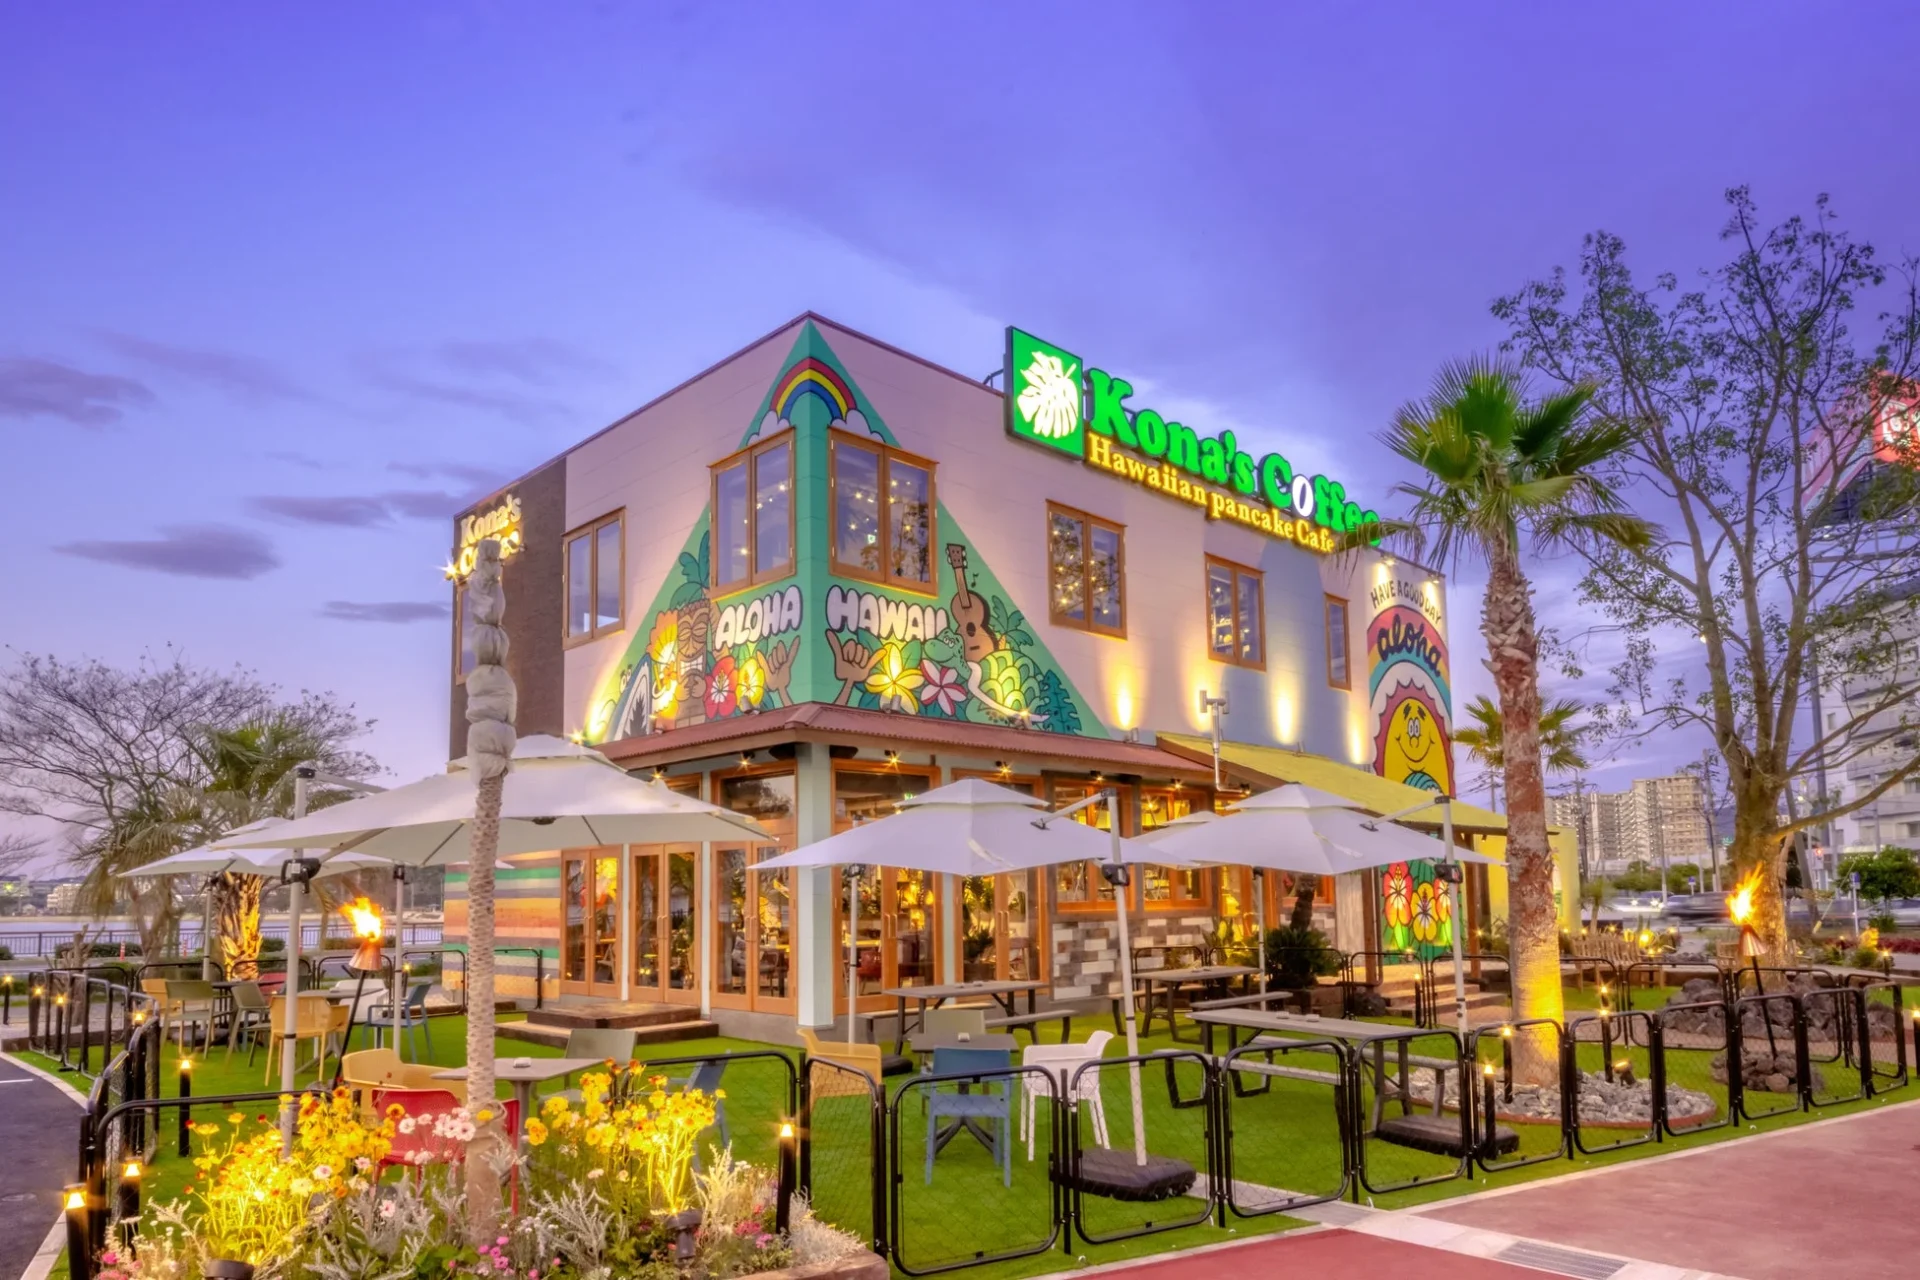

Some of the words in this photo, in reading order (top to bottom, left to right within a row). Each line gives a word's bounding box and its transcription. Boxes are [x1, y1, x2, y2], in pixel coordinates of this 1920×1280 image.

[1087, 367, 1256, 495] Kona's
[460, 493, 522, 548] Kona's
[1087, 430, 1208, 506] Hawaiian
[1210, 491, 1294, 540] pancake
[1296, 518, 1335, 553] Cafe
[715, 584, 803, 650] ALOHA
[825, 584, 950, 643] HAWAII
[1370, 580, 1396, 609] HAVE
[1398, 579, 1403, 596] A
[1404, 581, 1425, 608] GOOD
[1424, 598, 1442, 625] DAY
[1377, 613, 1441, 677] aloha
